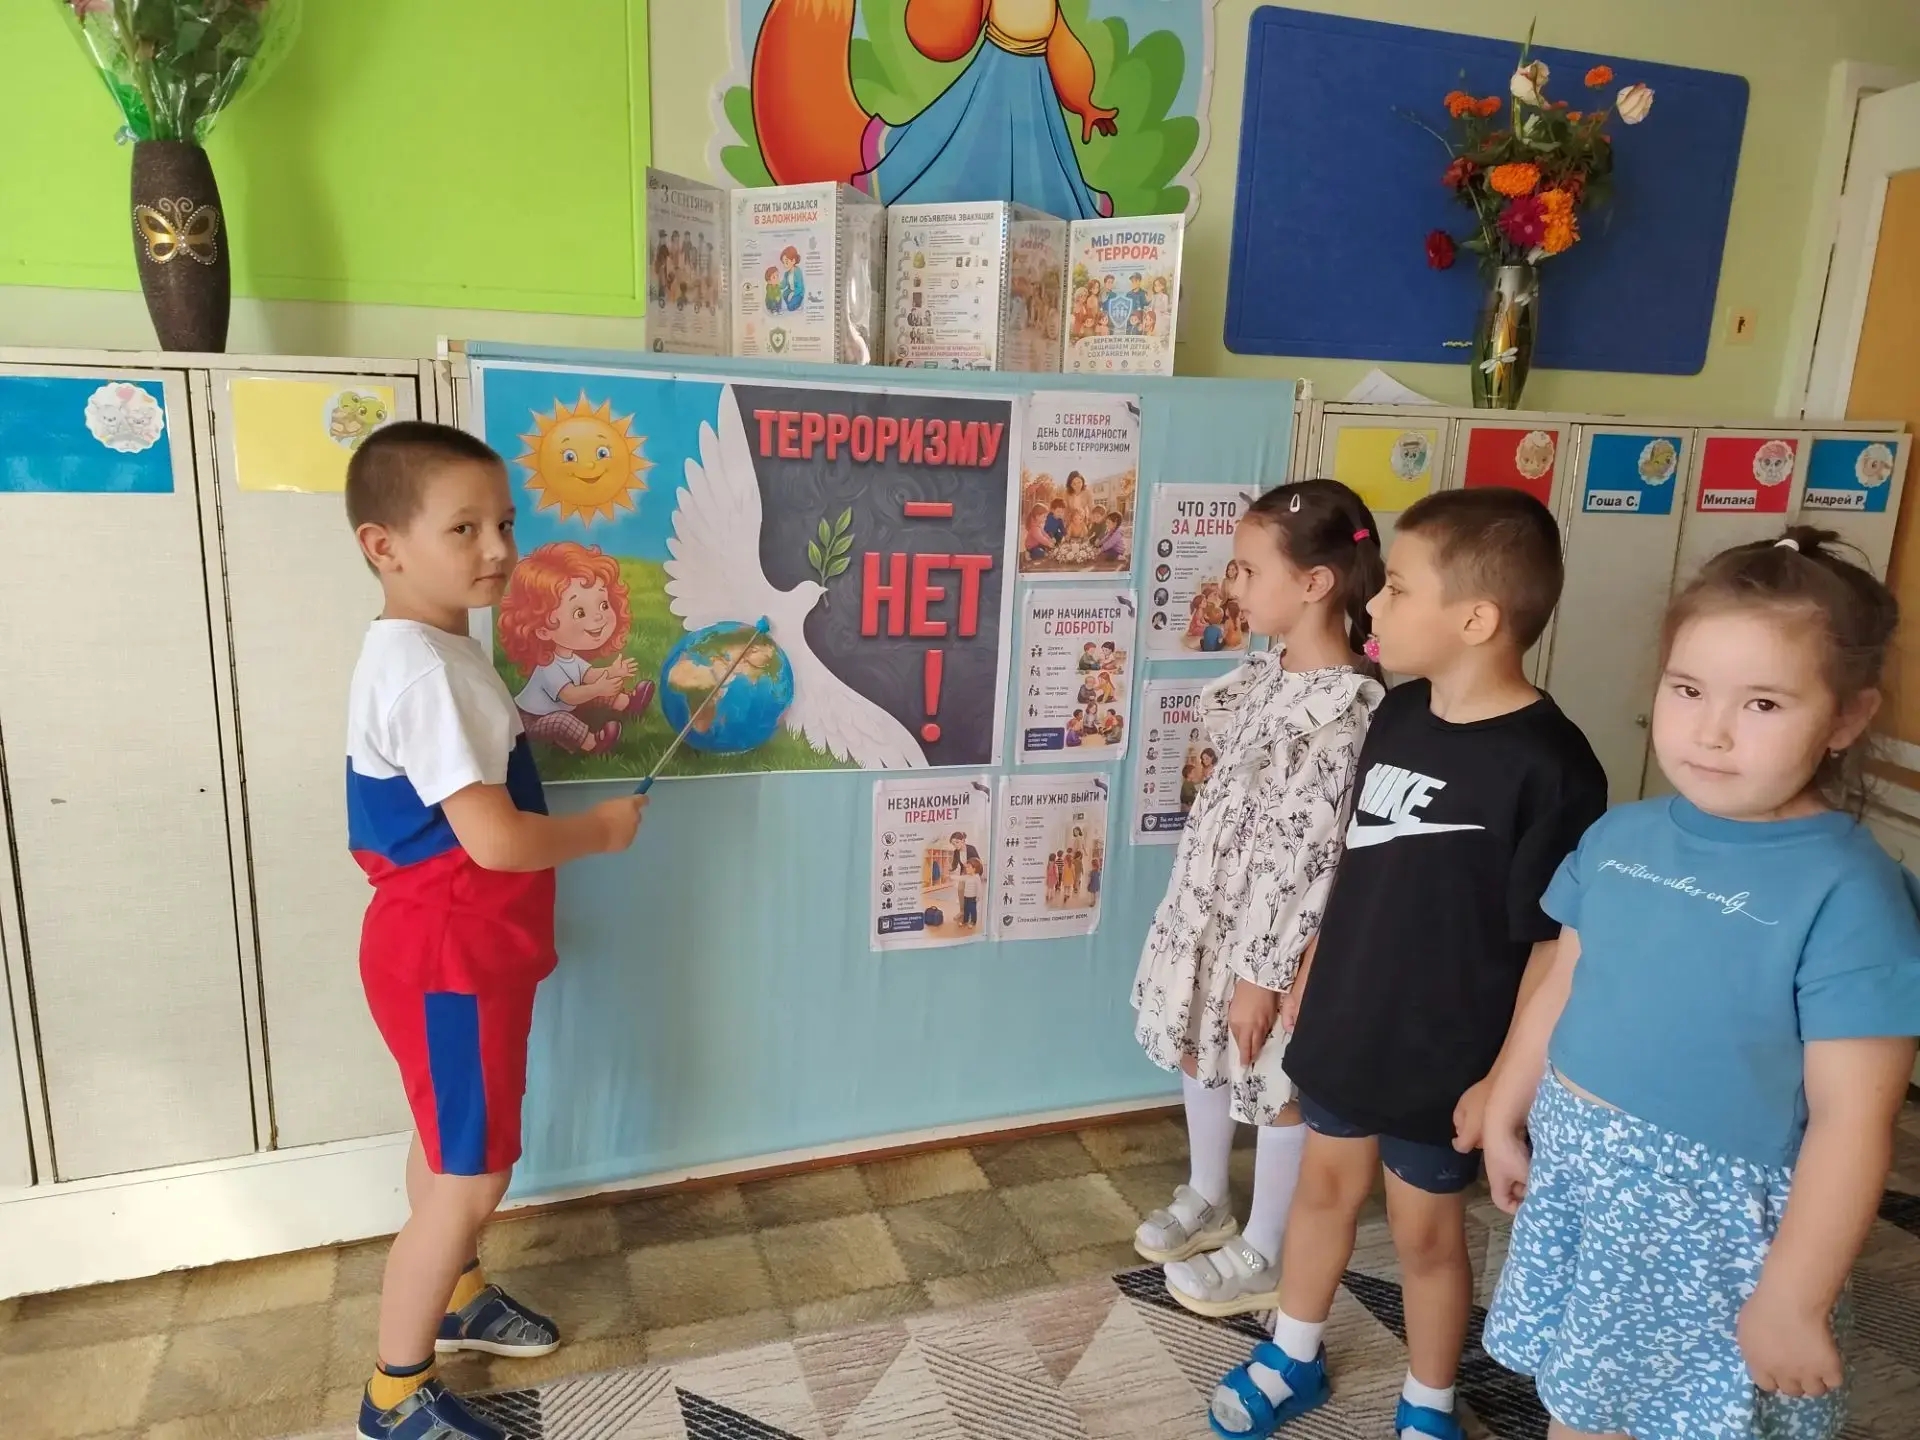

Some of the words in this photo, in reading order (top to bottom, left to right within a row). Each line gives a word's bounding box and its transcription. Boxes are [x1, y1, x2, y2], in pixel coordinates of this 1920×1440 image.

[661, 184, 669, 204] 3
[754, 204, 771, 213] ЕСЛИ
[772, 202, 782, 212] ТЫ
[783, 200, 818, 211] ОКАЗАЛСЯ
[754, 215, 760, 225] В
[761, 211, 818, 225] ЗАЛОЖНИКАХ
[901, 215, 918, 224] ЕСЛИ
[920, 214, 957, 223] ОБЪЯВЛЕНА
[959, 212, 995, 222] ЭВАКУАЦИЯ
[1091, 235, 1113, 248] МЫ
[1116, 231, 1166, 246] ПРОТИВ
[1096, 246, 1159, 262] ТЕРРОРА
[1055, 413, 1061, 425] 3
[1063, 413, 1111, 425] СЕНТЯБРЯ
[753, 409, 1004, 468] ТЕРРОРИЗМУ
[1036, 428, 1060, 439] ДЕНЬ
[1062, 427, 1128, 439] СОЛИДАРНОСТИ
[1032, 441, 1038, 451] В
[1039, 441, 1068, 452] БОРЬБЕ
[1070, 442, 1075, 452] С
[1077, 442, 1130, 453] ТЕРРОРИЗМОМ
[1588, 494, 1622, 507] Гоша
[1626, 495, 1638, 507] С.
[1703, 494, 1755, 505] Милана
[1805, 493, 1852, 507] Андрей
[1178, 501, 1204, 518] ЧТО
[1209, 501, 1237, 518] ЭТО
[1172, 519, 1190, 535] ЗА
[1194, 519, 1240, 537] ДЕНЬ
[861, 551, 993, 637] НЕТ
[1033, 608, 1055, 619] МИР
[1057, 607, 1121, 619] НАЧИНАЕТСЯ
[1044, 622, 1052, 635] С
[1054, 621, 1114, 636] ДОБРОТЫ
[887, 791, 970, 811] НЕЗНАКОМЫЙ
[1010, 795, 1034, 807] ЕСЛИ
[1036, 793, 1068, 806] НУЖНО
[1071, 790, 1100, 803] ВЫЙТИ
[1357, 762, 1447, 824] NIKE
[904, 808, 960, 824] ПРЕДМЕТ
[1597, 859, 1662, 883] positive
[1663, 876, 1707, 897] vibes
